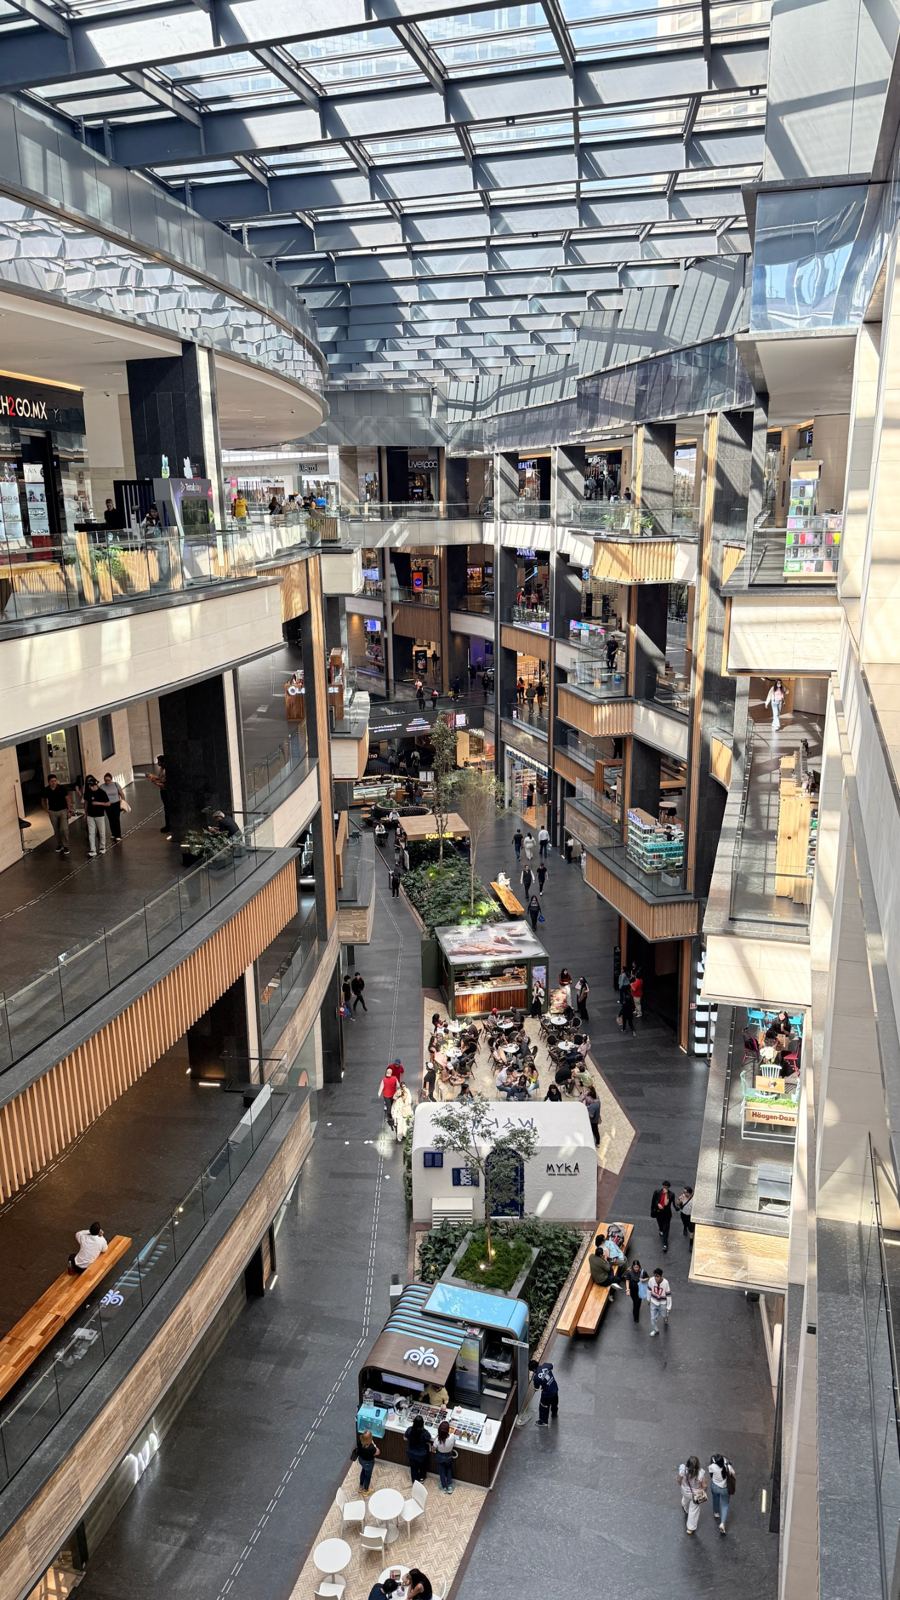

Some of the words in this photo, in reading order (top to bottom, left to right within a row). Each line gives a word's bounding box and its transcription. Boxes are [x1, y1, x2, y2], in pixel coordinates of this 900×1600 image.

[0, 395, 48, 420] H2GO.MX
[408, 460, 438, 469] Liverpoo
[546, 1162, 580, 1173] MYKA
